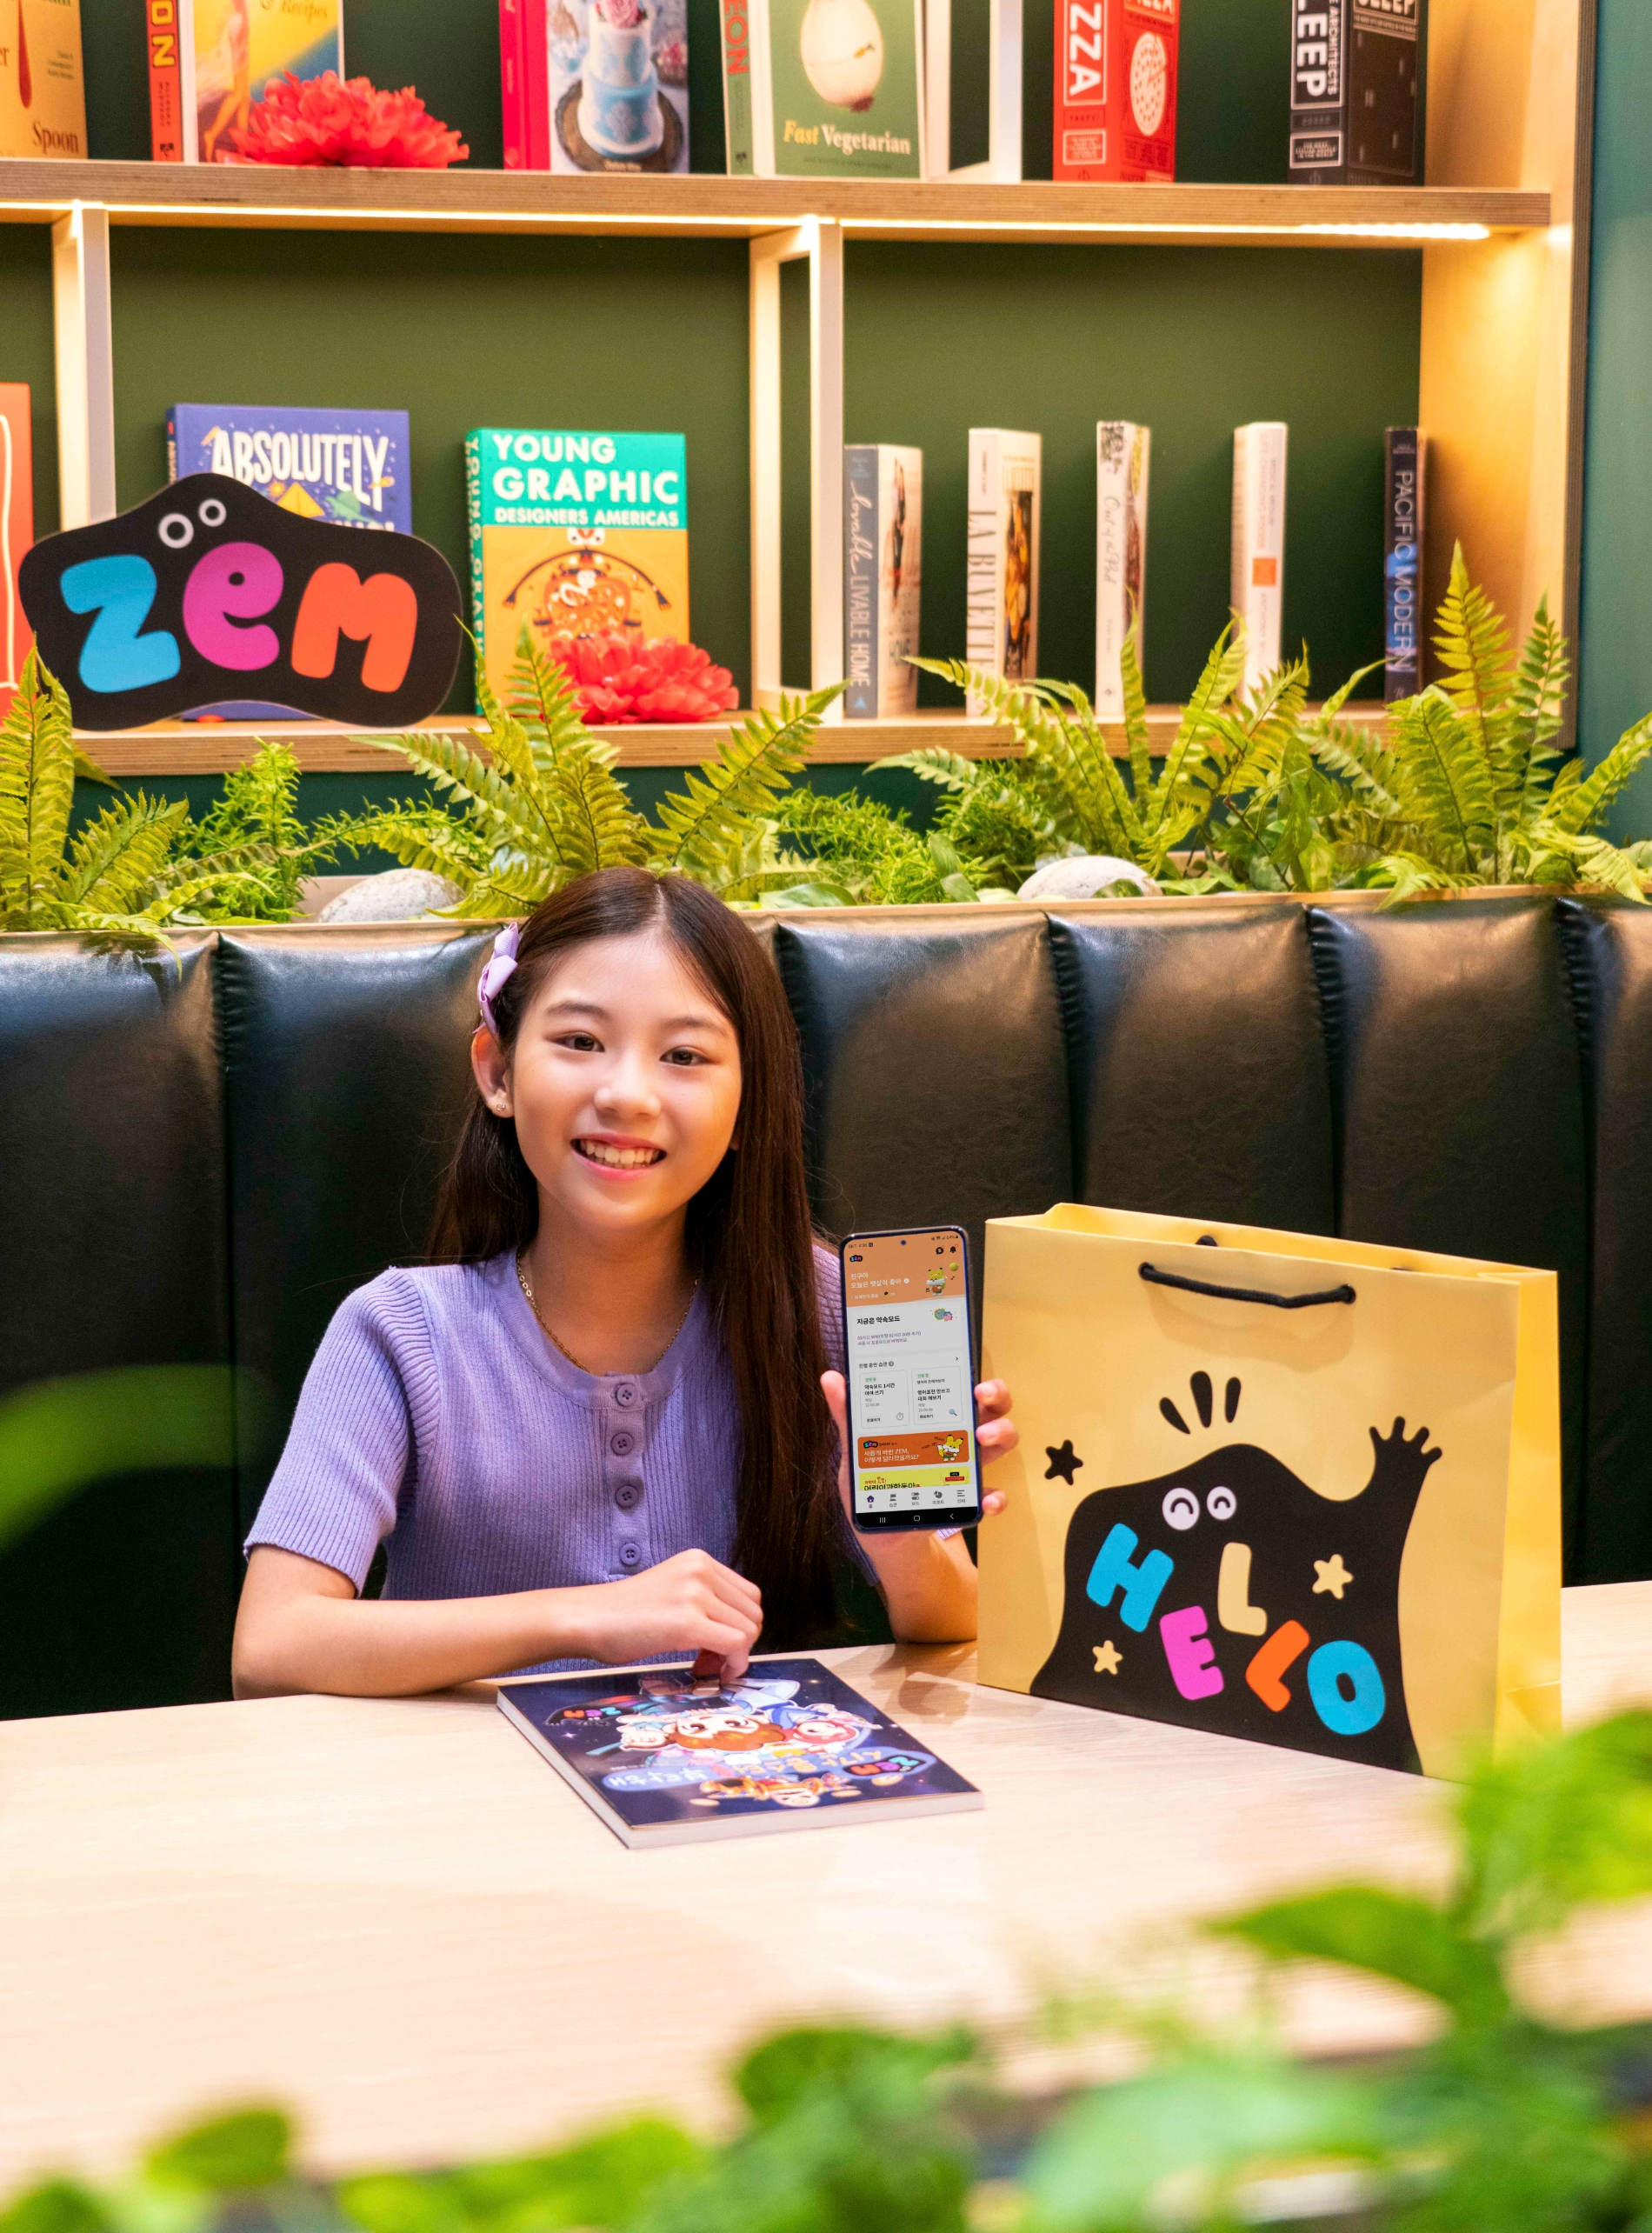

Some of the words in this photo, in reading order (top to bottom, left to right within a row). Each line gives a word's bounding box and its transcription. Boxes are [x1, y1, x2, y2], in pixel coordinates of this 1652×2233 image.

[1327, 7, 1340, 96] ARCHITECTS
[32, 120, 79, 155] Spoon
[783, 119, 819, 146] Fast
[821, 123, 911, 156] Vegetarian
[211, 430, 390, 512] ABSOLUTELY
[492, 434, 616, 463] YOUNG
[492, 467, 679, 504] GRAPHIC
[495, 506, 589, 525] DESIGNERS
[593, 509, 678, 528] AMERICAS
[850, 481, 873, 575] lovable
[968, 510, 996, 539] LA
[1394, 470, 1414, 562] PACIFIC
[1103, 554, 1119, 585] Pod
[60, 542, 417, 693] zem
[850, 575, 870, 638] LIVABLE
[1394, 569, 1414, 670] MODERN
[850, 643, 870, 688] HOME
[1087, 1523, 1385, 1735] HELLO
